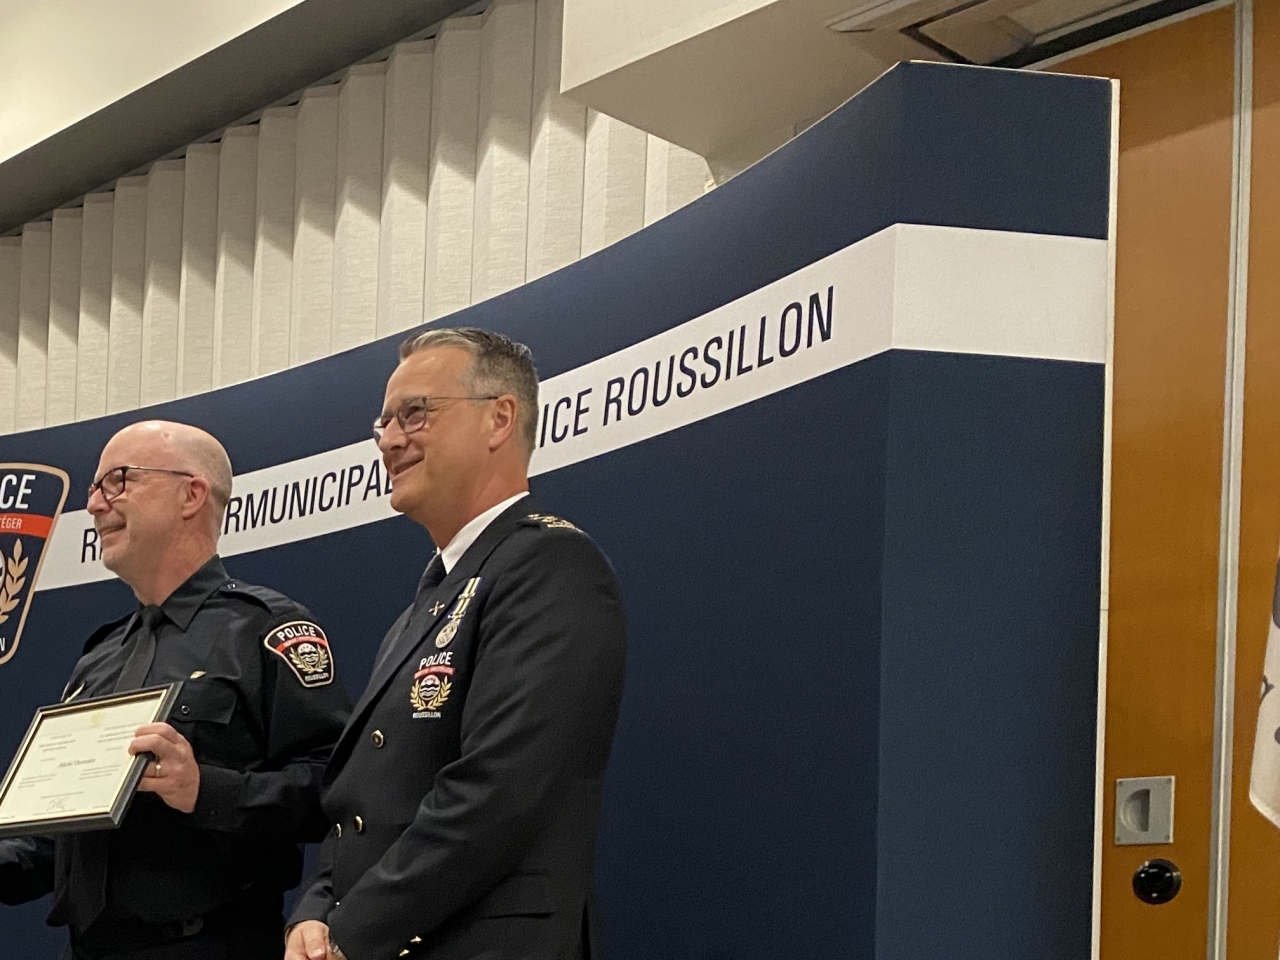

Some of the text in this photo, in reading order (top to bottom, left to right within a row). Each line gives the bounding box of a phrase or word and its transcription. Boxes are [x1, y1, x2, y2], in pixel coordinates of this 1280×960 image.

[223, 285, 834, 535] RMUNICIPAL ICE ROUSSILLON
[277, 625, 317, 641] POLICE
[419, 651, 454, 671] POLICE
